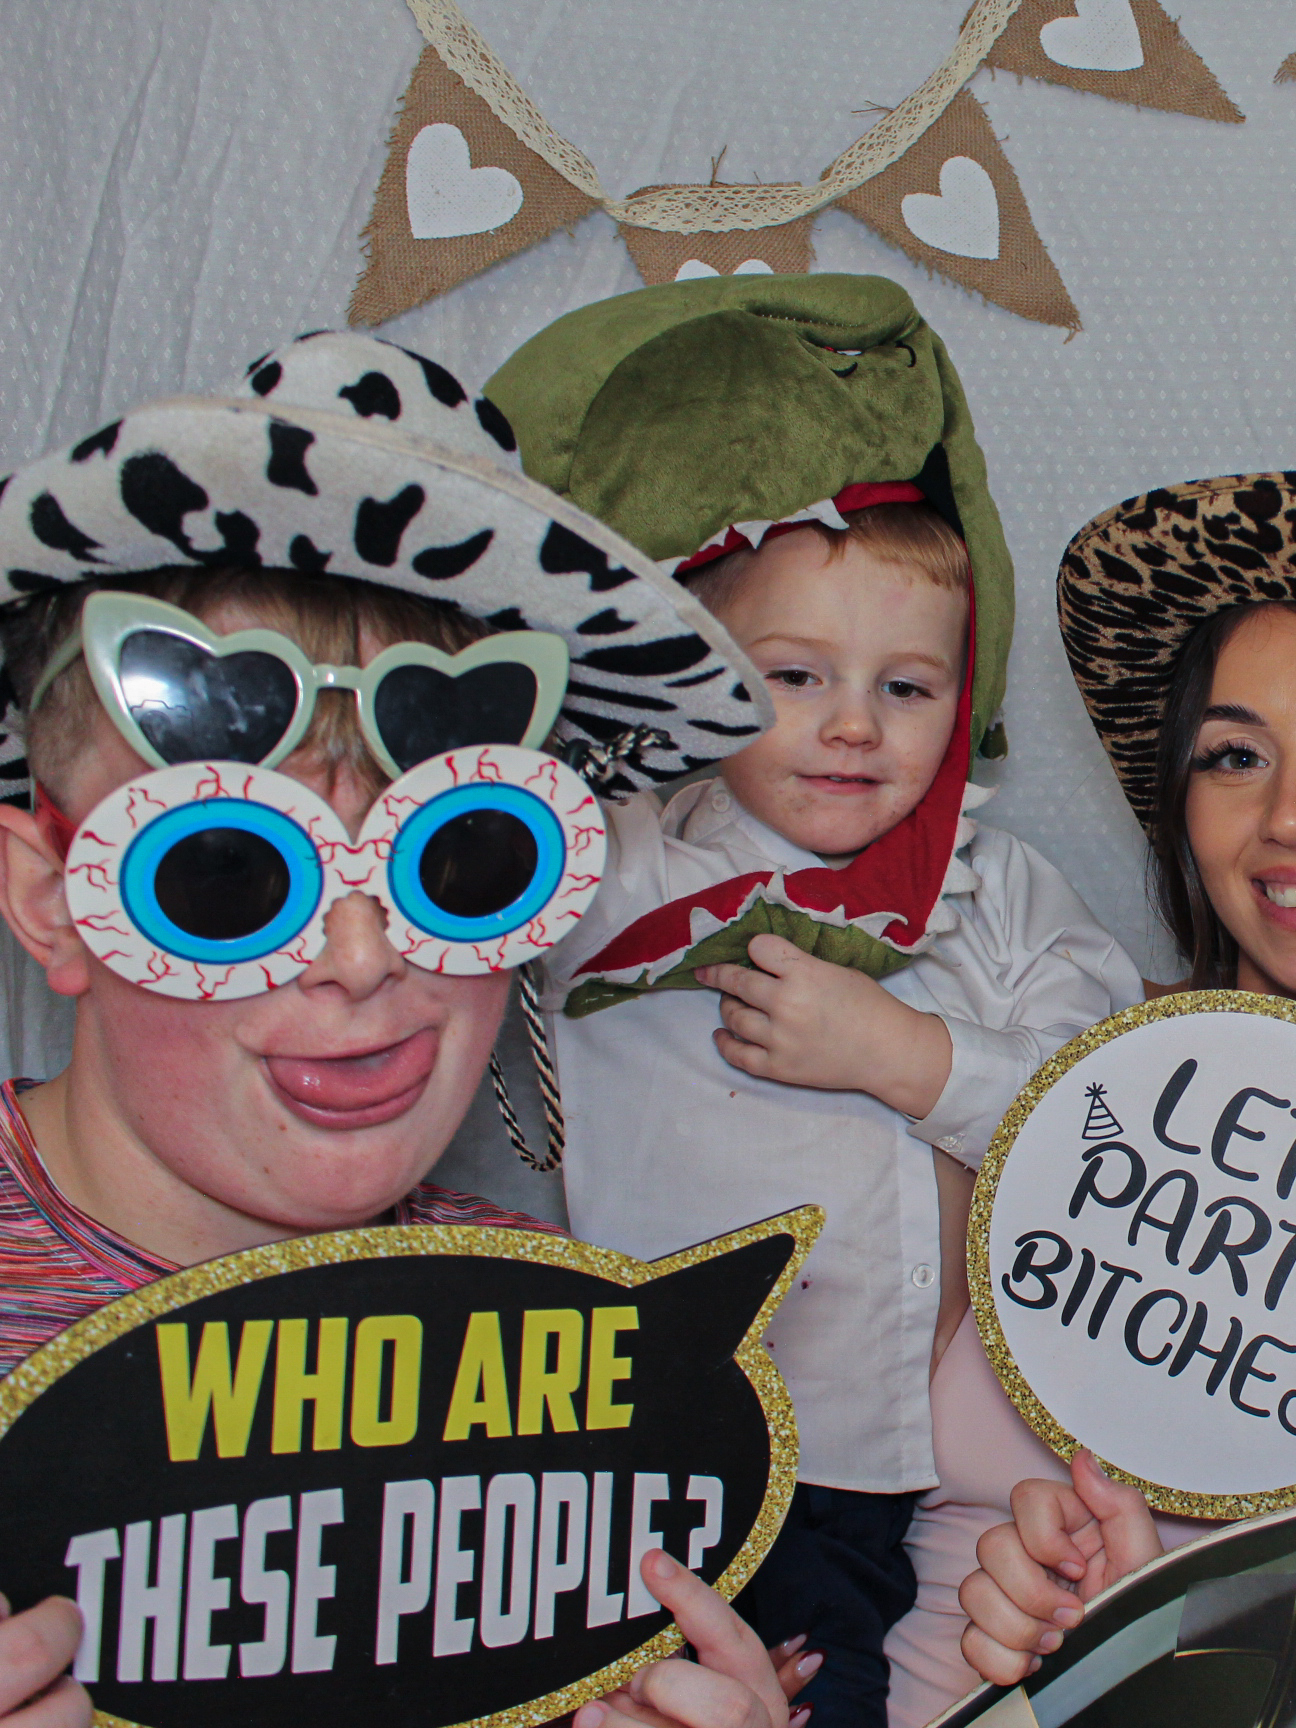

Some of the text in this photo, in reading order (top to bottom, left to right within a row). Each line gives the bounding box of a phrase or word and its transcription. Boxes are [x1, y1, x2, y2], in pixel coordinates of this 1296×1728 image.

[155, 1305, 640, 1462] WHO ARE
[63, 1471, 725, 1684] THESE PEOPLE?
